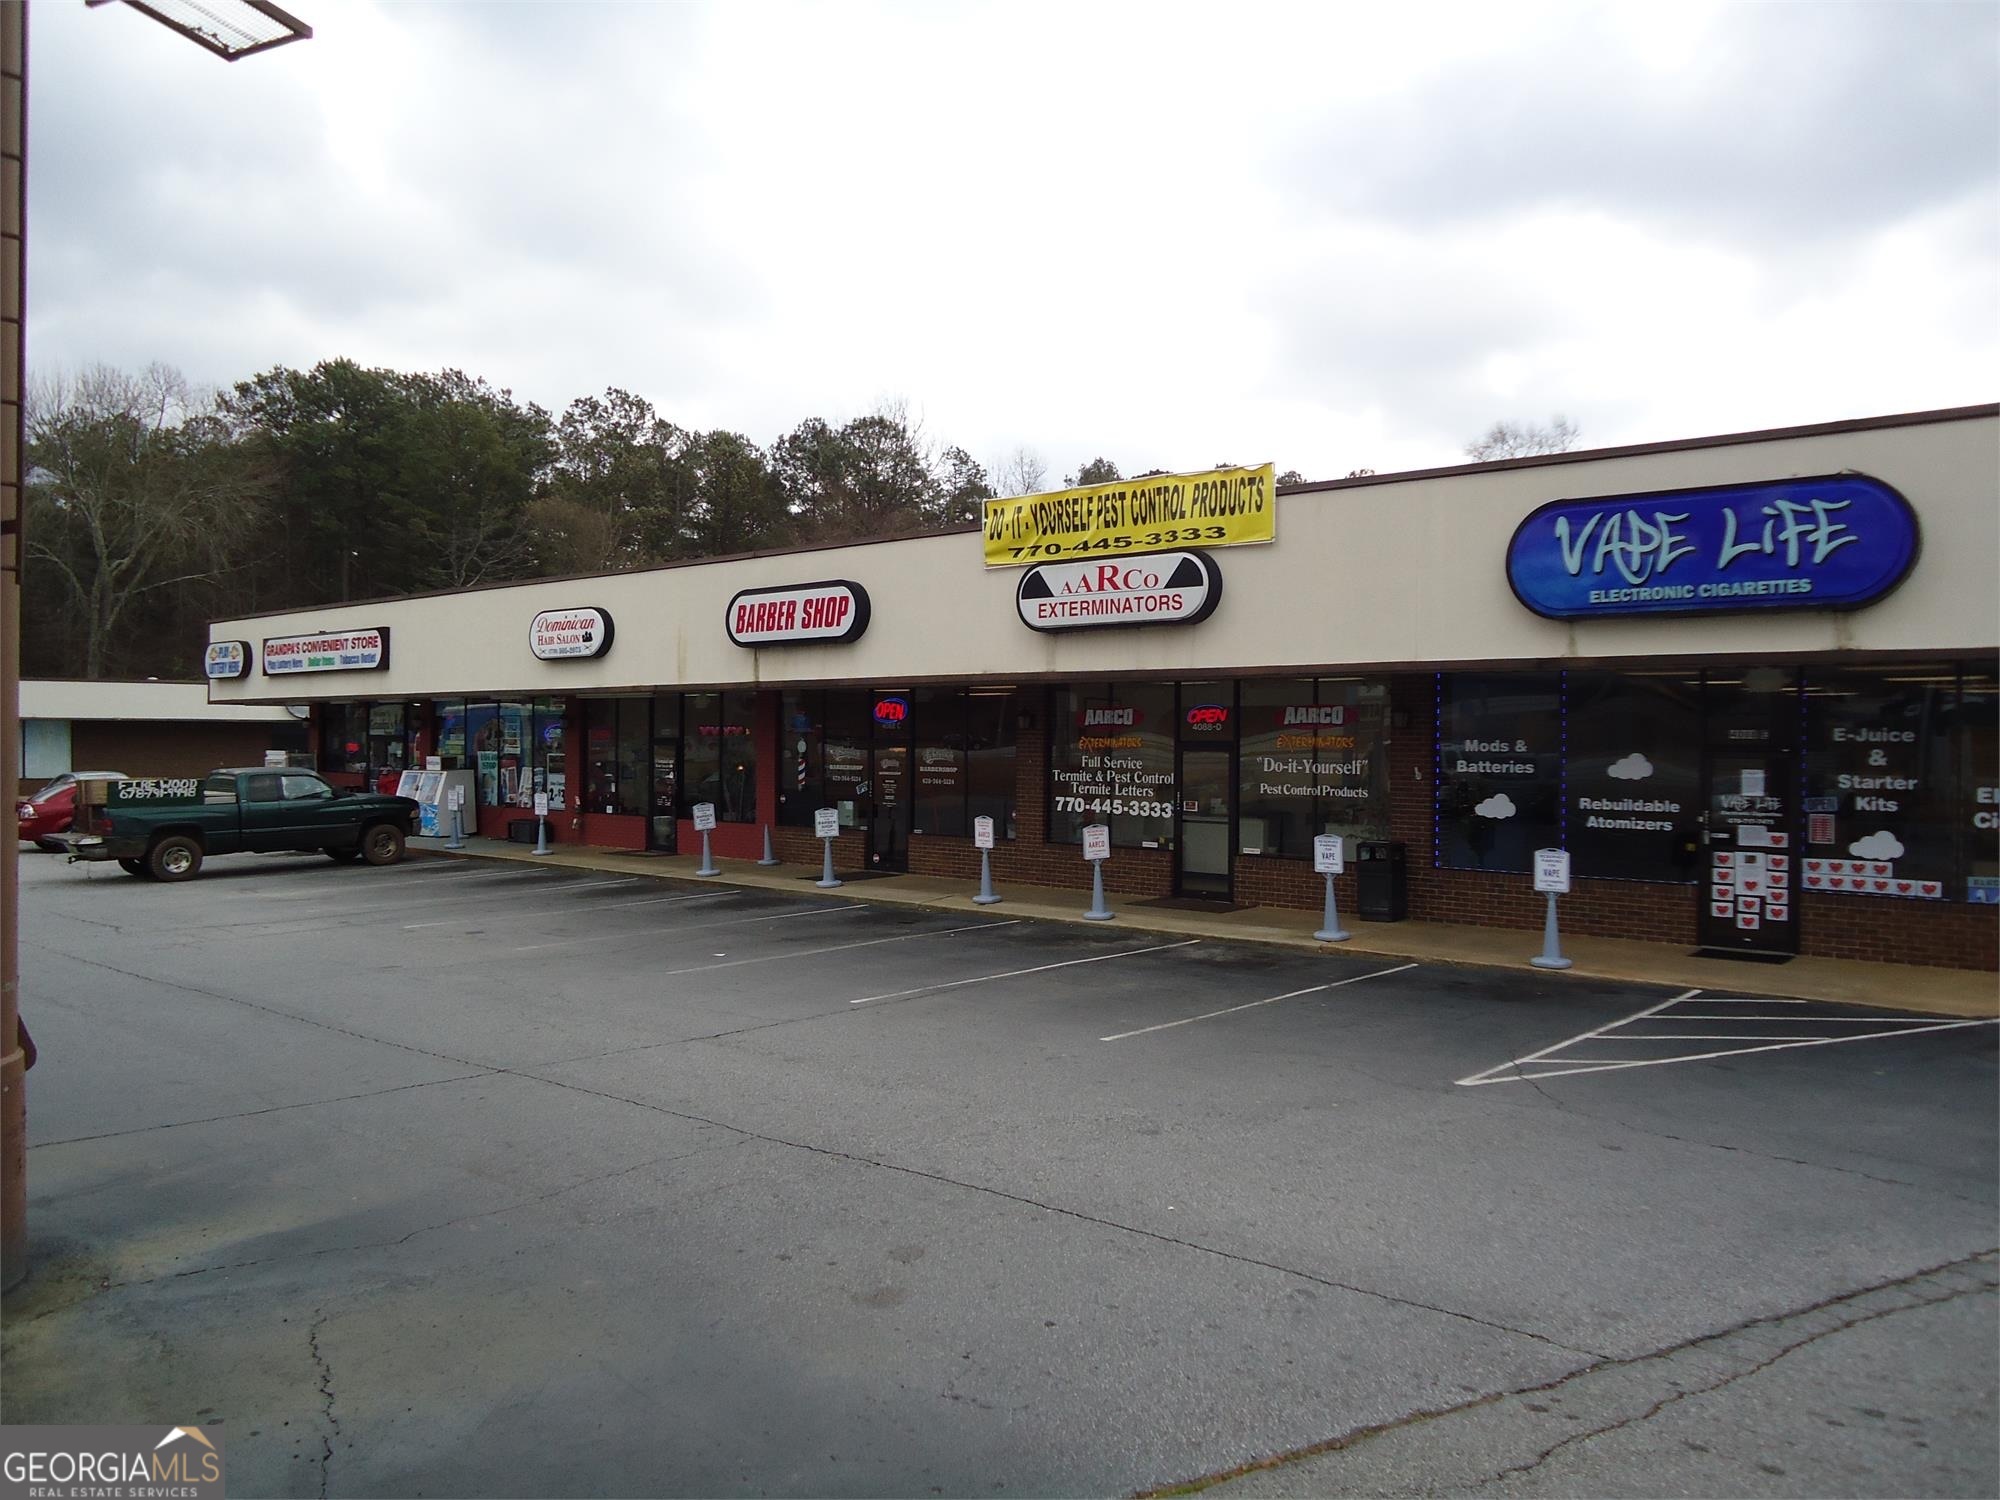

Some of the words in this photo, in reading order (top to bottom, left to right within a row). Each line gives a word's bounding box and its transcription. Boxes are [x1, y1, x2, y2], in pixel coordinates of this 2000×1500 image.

[989, 507, 1005, 541] DO
[1012, 505, 1023, 540] IT
[1030, 496, 1094, 536] YOURSELF
[1096, 491, 1127, 530] PEST
[1130, 484, 1187, 527] CONTROL
[1190, 475, 1265, 518] PRODUCTS
[1007, 526, 1227, 559] 770-445-3333
[1554, 508, 1697, 585] VAPE
[1589, 584, 1695, 604] ELECTRONIC
[1699, 579, 1812, 599] CIGARETTES
[736, 600, 797, 634] BARBER
[801, 595, 850, 629] SHOP
[1038, 593, 1183, 619] EXTERMINATORS
[536, 615, 595, 633] Dominican
[266, 642, 300, 657] GRANDPA'S
[301, 638, 350, 653] CONVENIENT
[350, 635, 379, 650] STORE
[556, 633, 581, 645] SALON
[876, 701, 904, 720] OPEN
[1084, 708, 1135, 726] AARCO
[1187, 707, 1229, 724] OPEN
[1283, 705, 1345, 726] AARCO
[1833, 727, 1915, 742] E-Juice
[1464, 740, 1510, 752] Mods
[1515, 740, 1528, 752] &
[1081, 755, 1101, 768] Full
[1103, 755, 1143, 769] Service
[1868, 749, 1888, 766] &
[1456, 760, 1535, 774] Batteries
[1052, 769, 1093, 782] Termite
[1095, 770, 1104, 782] &
[1106, 770, 1131, 783] Pest
[1133, 771, 1174, 785] Control
[1838, 774, 1918, 790] Starter
[1071, 781, 1111, 795] Termite
[1114, 783, 1155, 797] Letters
[1259, 783, 1282, 795] Pest
[1283, 783, 1321, 796] Control
[1322, 785, 1369, 798] Products
[1055, 796, 1173, 819] 770-445-3333
[1578, 797, 1681, 813] Rebuildable
[1855, 796, 1899, 812] Kits
[1586, 815, 1673, 831] Atomizers
